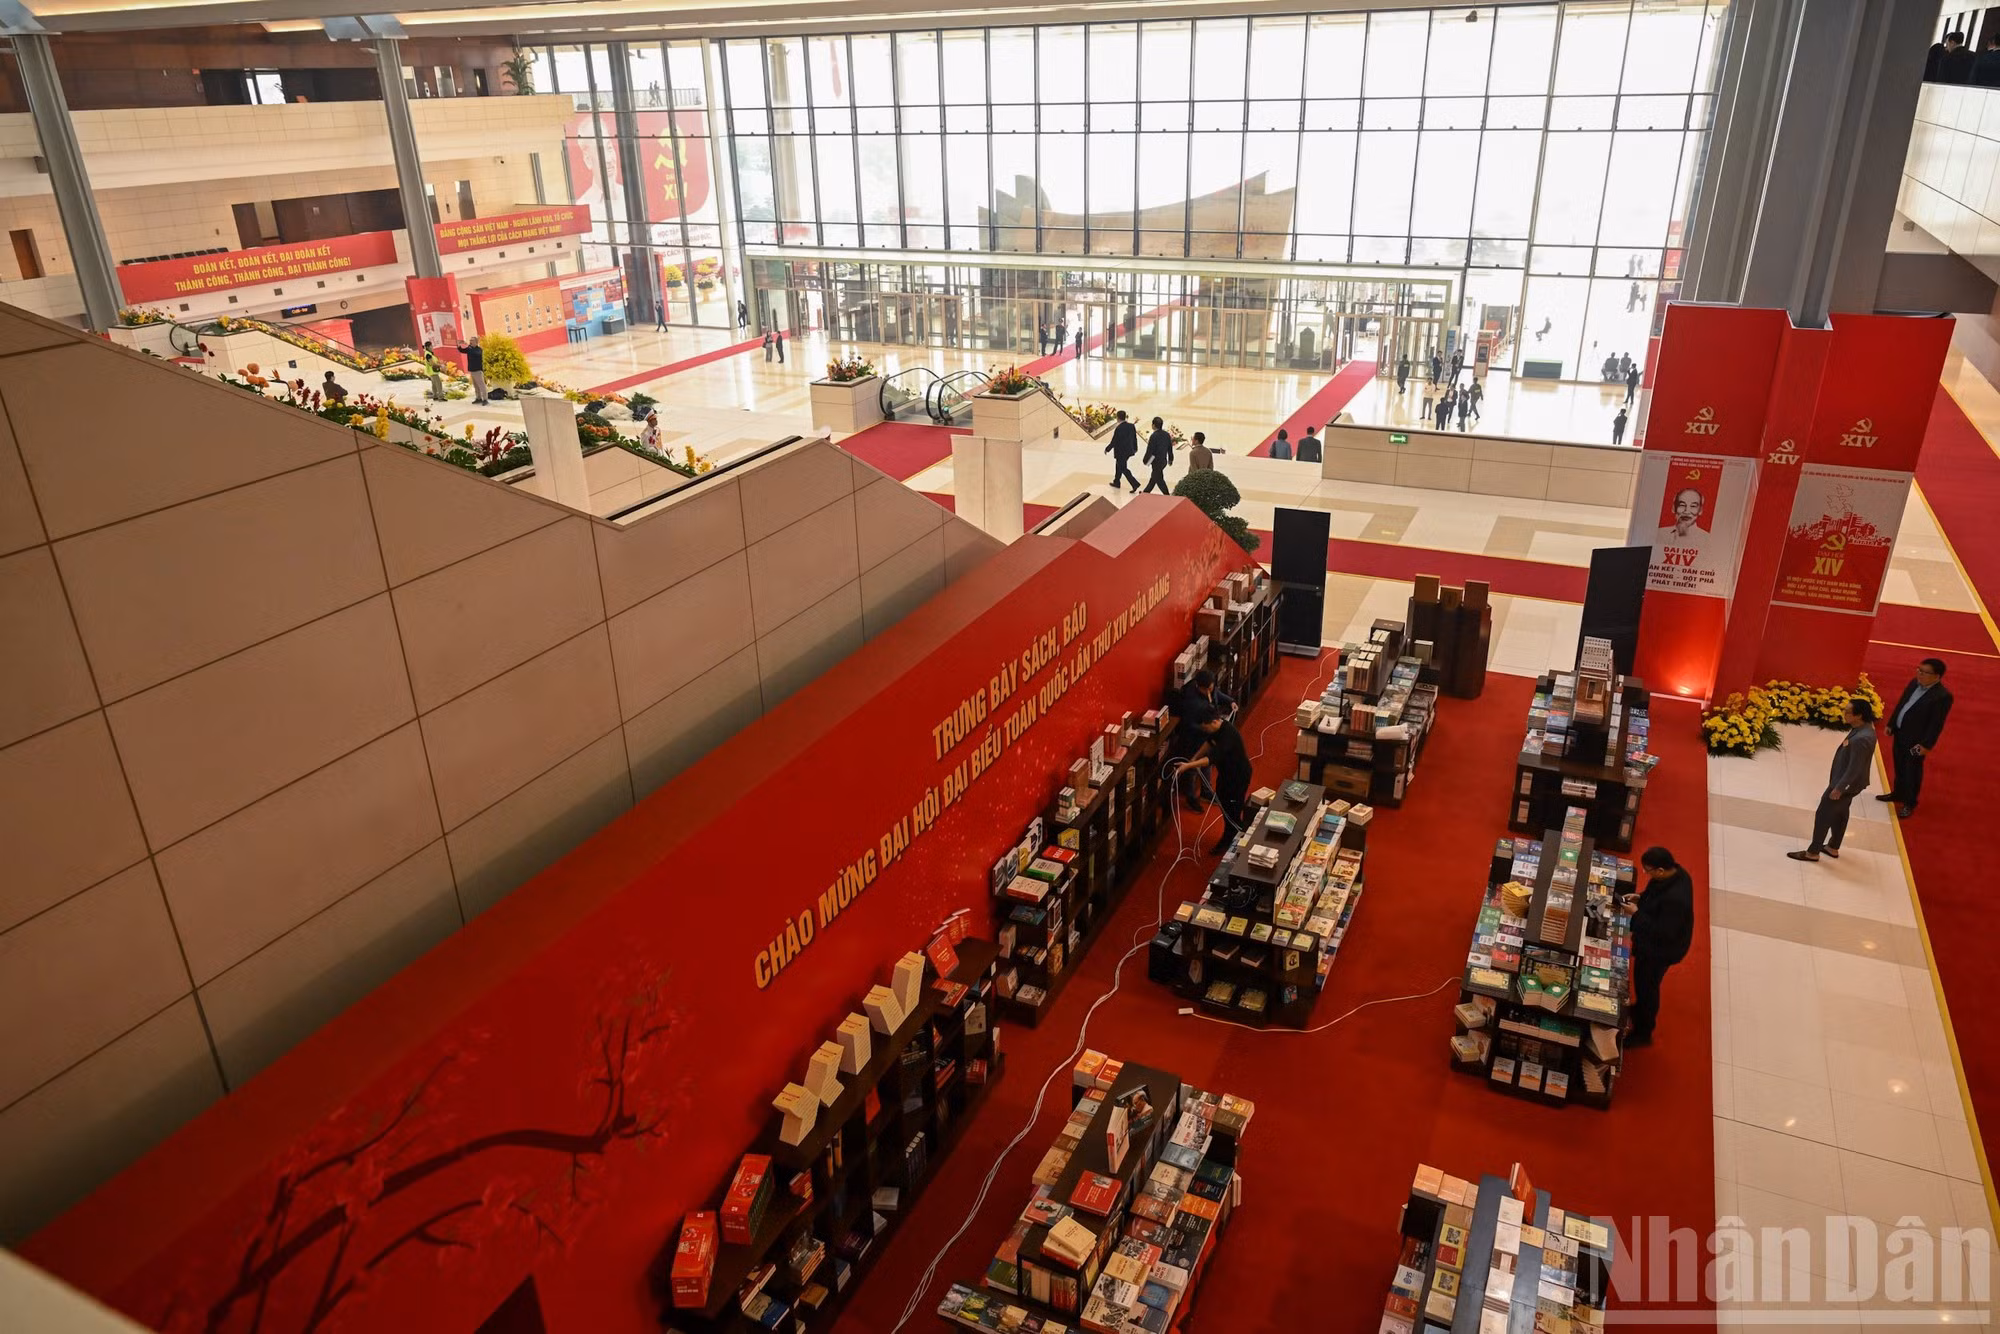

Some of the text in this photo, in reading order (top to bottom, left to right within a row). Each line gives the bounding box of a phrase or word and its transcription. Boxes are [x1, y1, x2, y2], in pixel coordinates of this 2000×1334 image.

[472, 223, 485, 234] SẢN
[484, 222, 496, 233] VIỆT
[497, 221, 509, 230] NAM
[538, 226, 549, 236] VIỆT
[193, 244, 331, 274] ĐOÀN KẾT, ĐOÀN KẾT, ĐẠI ĐOÀN KẾT
[175, 255, 351, 292] THÀNH CÔNG, THÀNH CÔNG, ĐẠI THÀNH CÔNG!
[1684, 422, 1720, 435] XIV
[1840, 434, 1878, 448] XIV
[1767, 452, 1800, 465] XIV
[1663, 553, 1697, 566] XIV
[1812, 556, 1844, 576] XIV
[1661, 564, 1675, 572] KẾT
[1651, 578, 1697, 589] PHÁT TRIỂN!
[932, 601, 1087, 760] TRƯNG BÀY SÁCH, BÁO
[754, 572, 1170, 989] CHÀO MỪNG ĐẠI HỘI ĐẠI BIỂU TOÀN QUỐC LẦN THỨ XIV CỦA ĐẢNG
